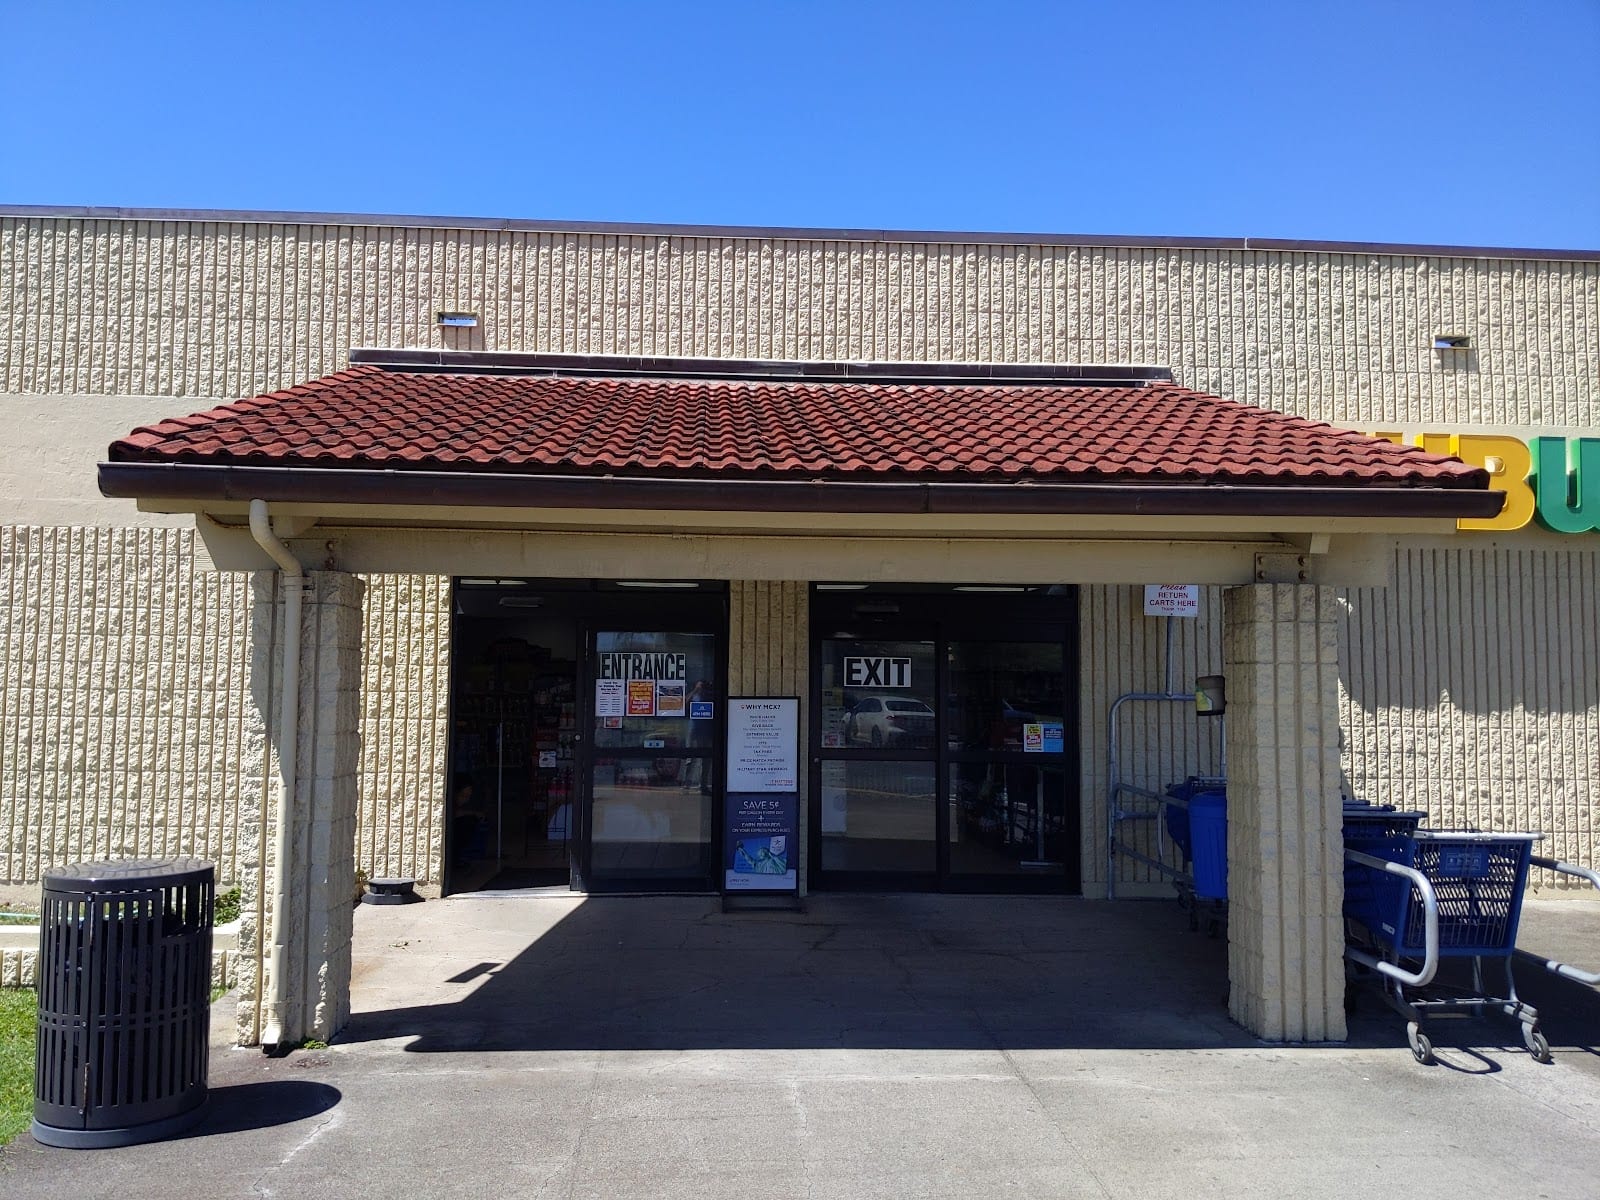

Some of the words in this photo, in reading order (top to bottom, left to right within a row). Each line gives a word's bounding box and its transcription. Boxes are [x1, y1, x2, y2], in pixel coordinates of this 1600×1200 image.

[601, 654, 685, 680] ENTRANCE
[846, 658, 910, 686] EXIT
[743, 800, 767, 810] SAVE
